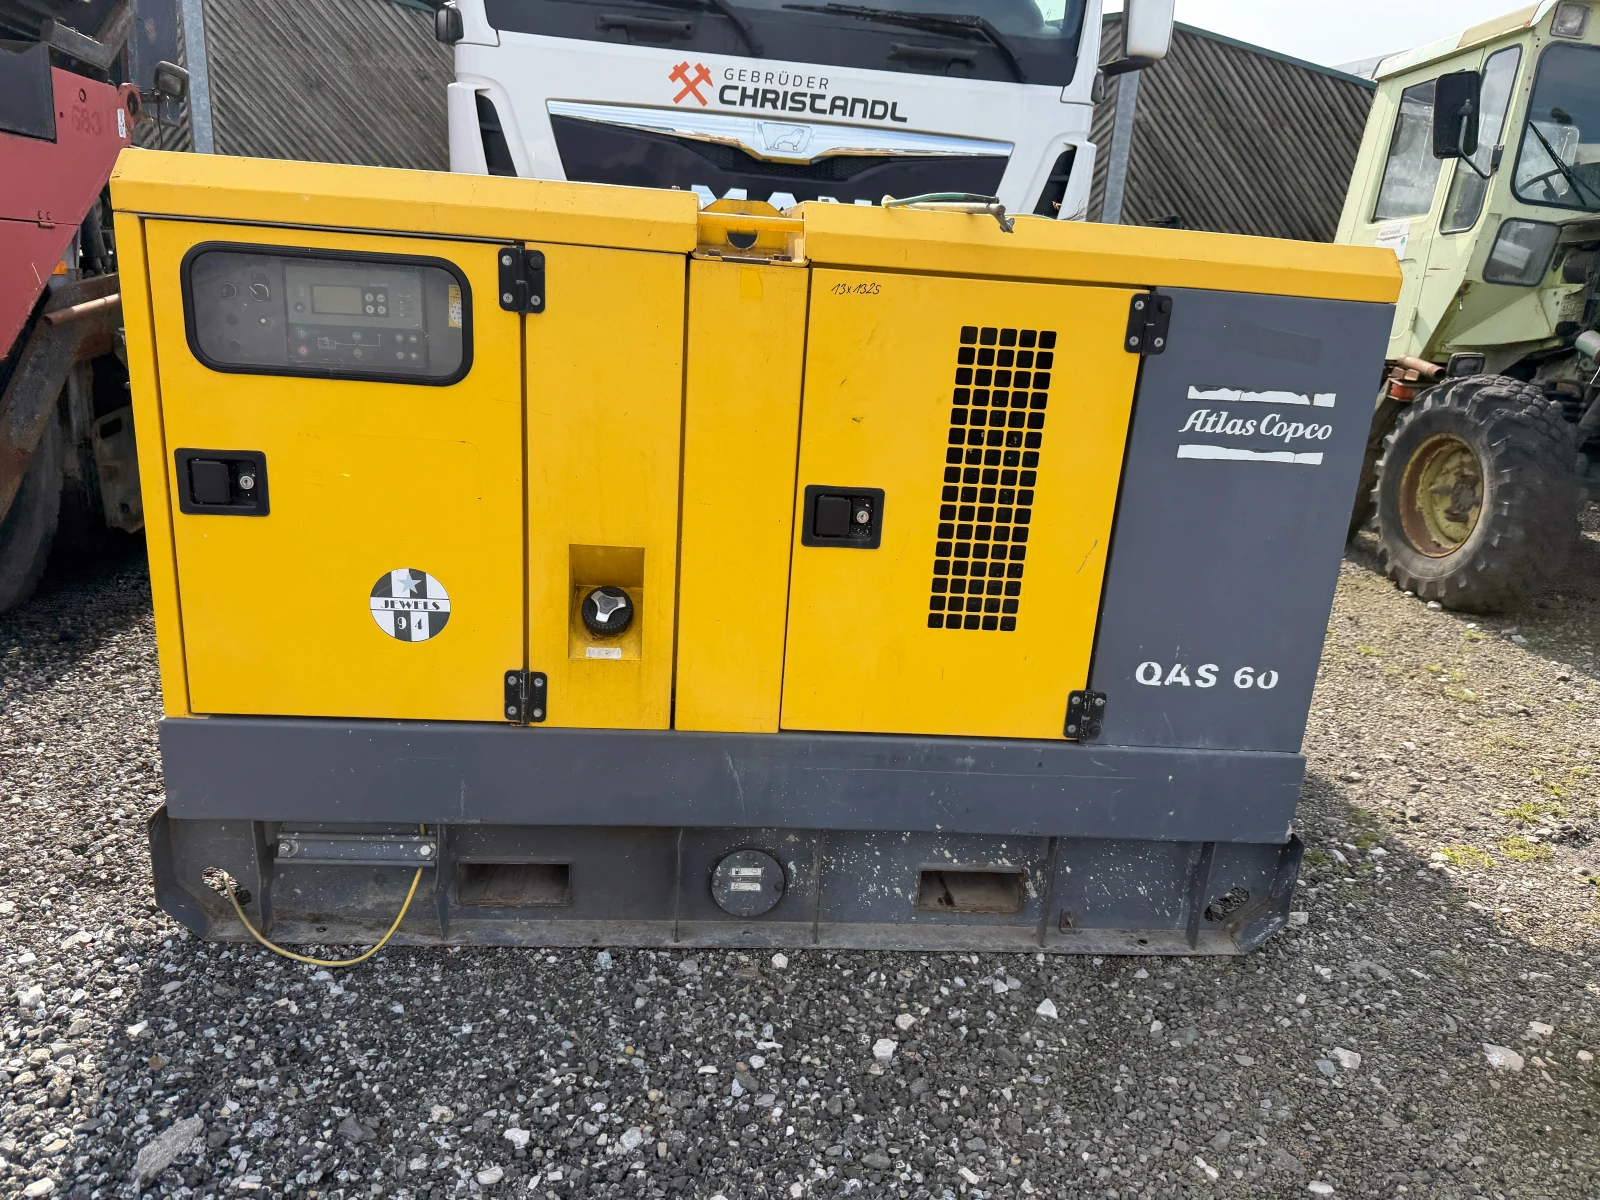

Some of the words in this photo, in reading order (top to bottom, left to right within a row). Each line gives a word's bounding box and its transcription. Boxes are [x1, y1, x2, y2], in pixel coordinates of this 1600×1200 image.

[723, 68, 830, 90] GEBRÜDER
[718, 84, 908, 123] CHRISTANDL
[1178, 408, 1257, 436] Atlas
[1259, 413, 1333, 443] Copco
[380, 599, 440, 611] JEWELS
[396, 616, 407, 630] 9
[1135, 661, 1220, 688] QAS
[1233, 666, 1279, 690] 60
